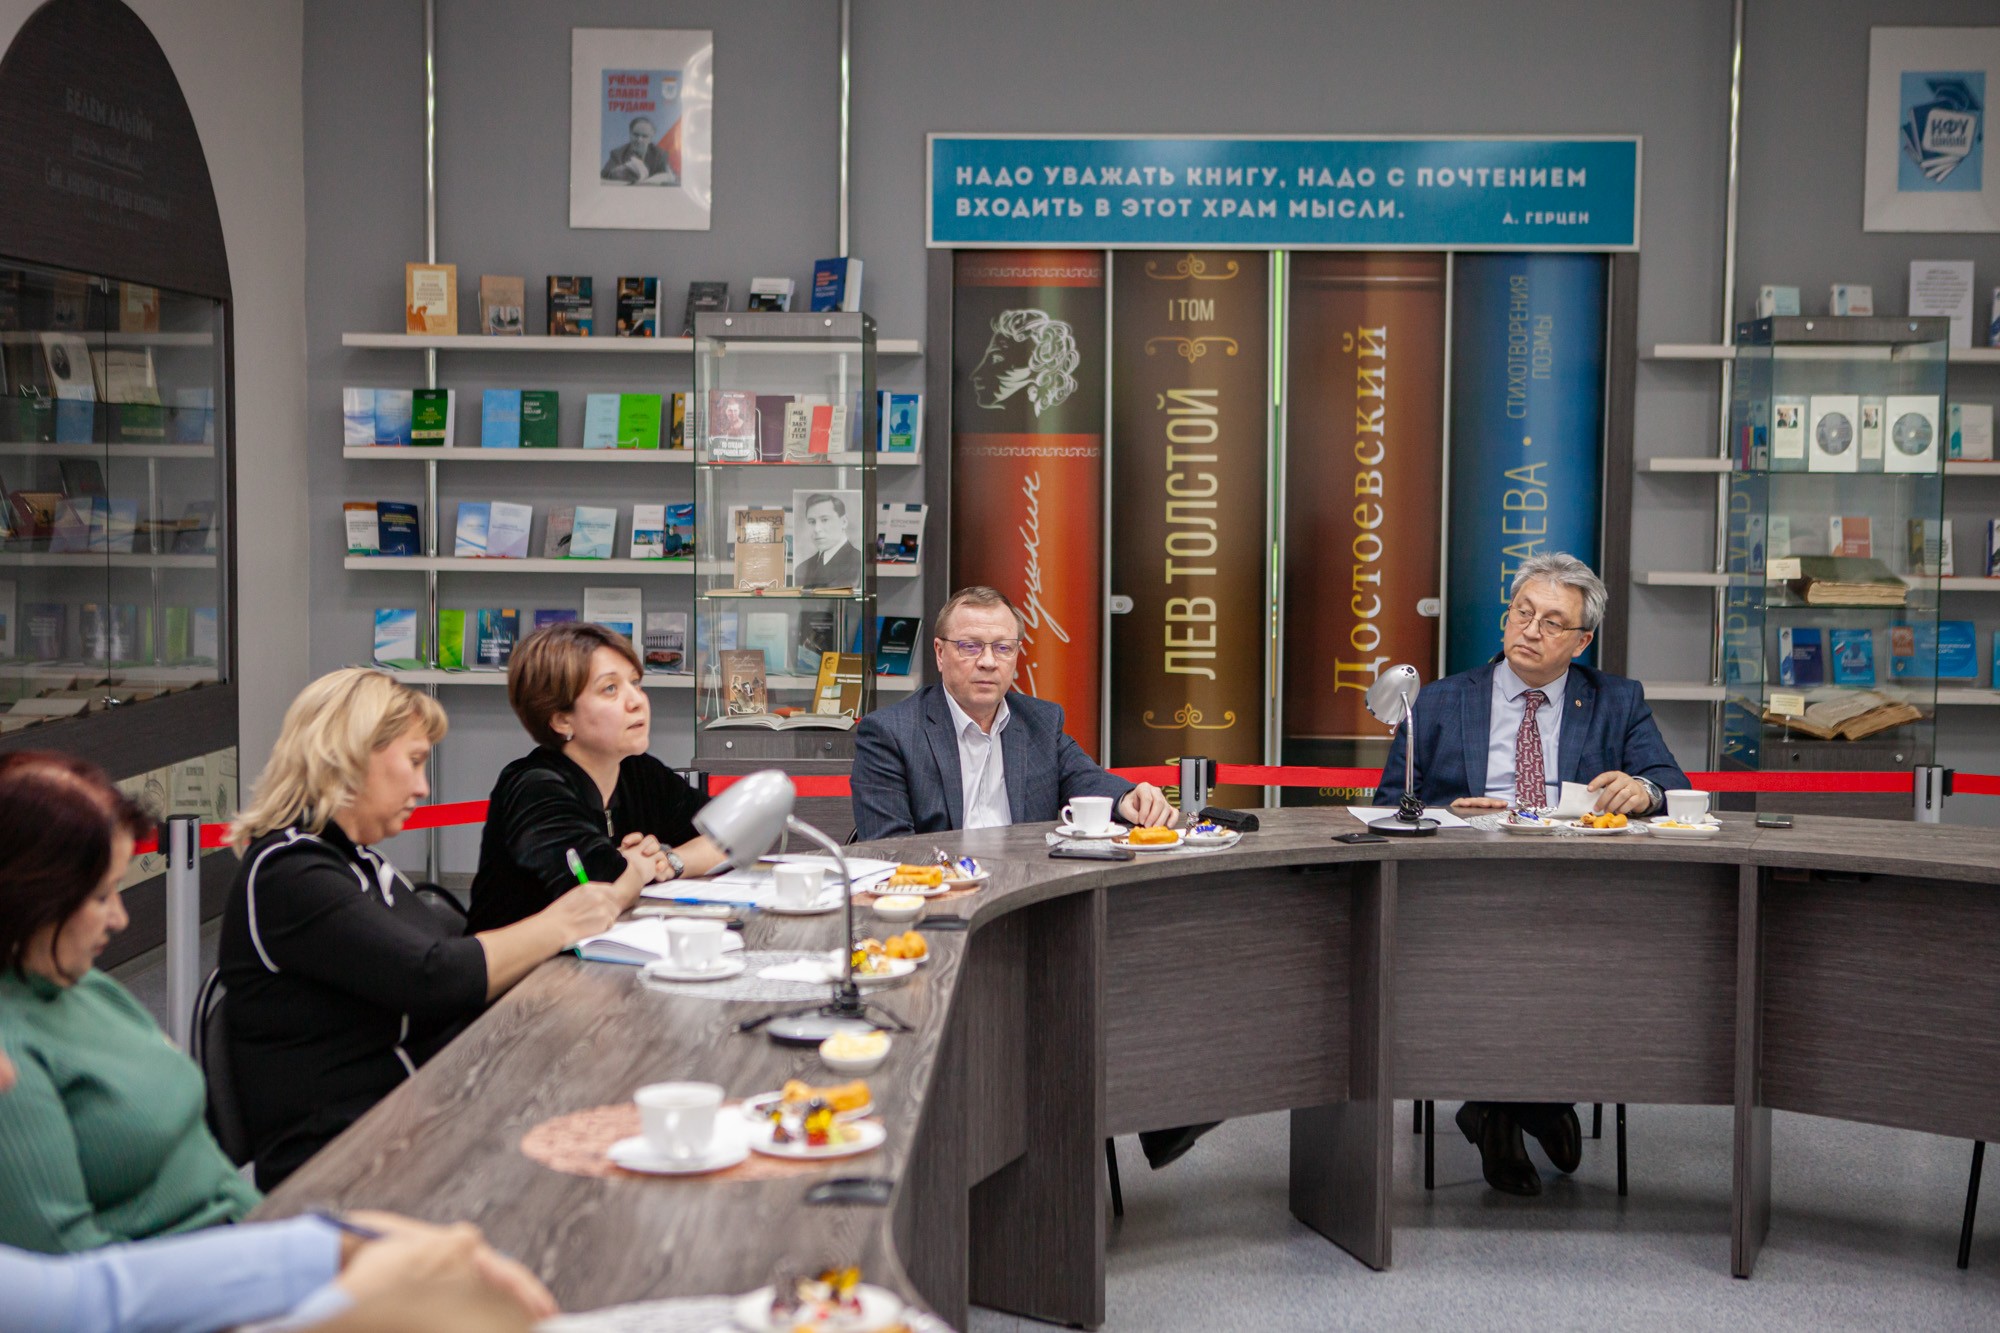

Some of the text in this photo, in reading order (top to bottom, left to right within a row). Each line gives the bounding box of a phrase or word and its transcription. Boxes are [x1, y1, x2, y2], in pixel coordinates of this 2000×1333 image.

[608, 88, 648, 99] СЛАВЕН
[608, 101, 656, 113] ТРУДАМИ
[956, 166, 1587, 188] НАДО УВАЖАТЬ КНИГУ, НАДО С ПОЧТЕНИЕМ
[956, 198, 1406, 219] ВХОДИТЬ В ЭТОТ ХРАМ МЫСЛИ.
[1502, 212, 1590, 226] А. ГЕРЦЕН
[1177, 298, 1215, 322] ТОМ
[1507, 274, 1529, 419] СТИХОТВОРЕНИЯ
[1532, 314, 1553, 380] ПОЭМЫ
[738, 511, 784, 527] Mussa
[1334, 325, 1391, 693] Достоевский
[1156, 389, 1219, 681] ЛЕВ ТОЛСТОЙ
